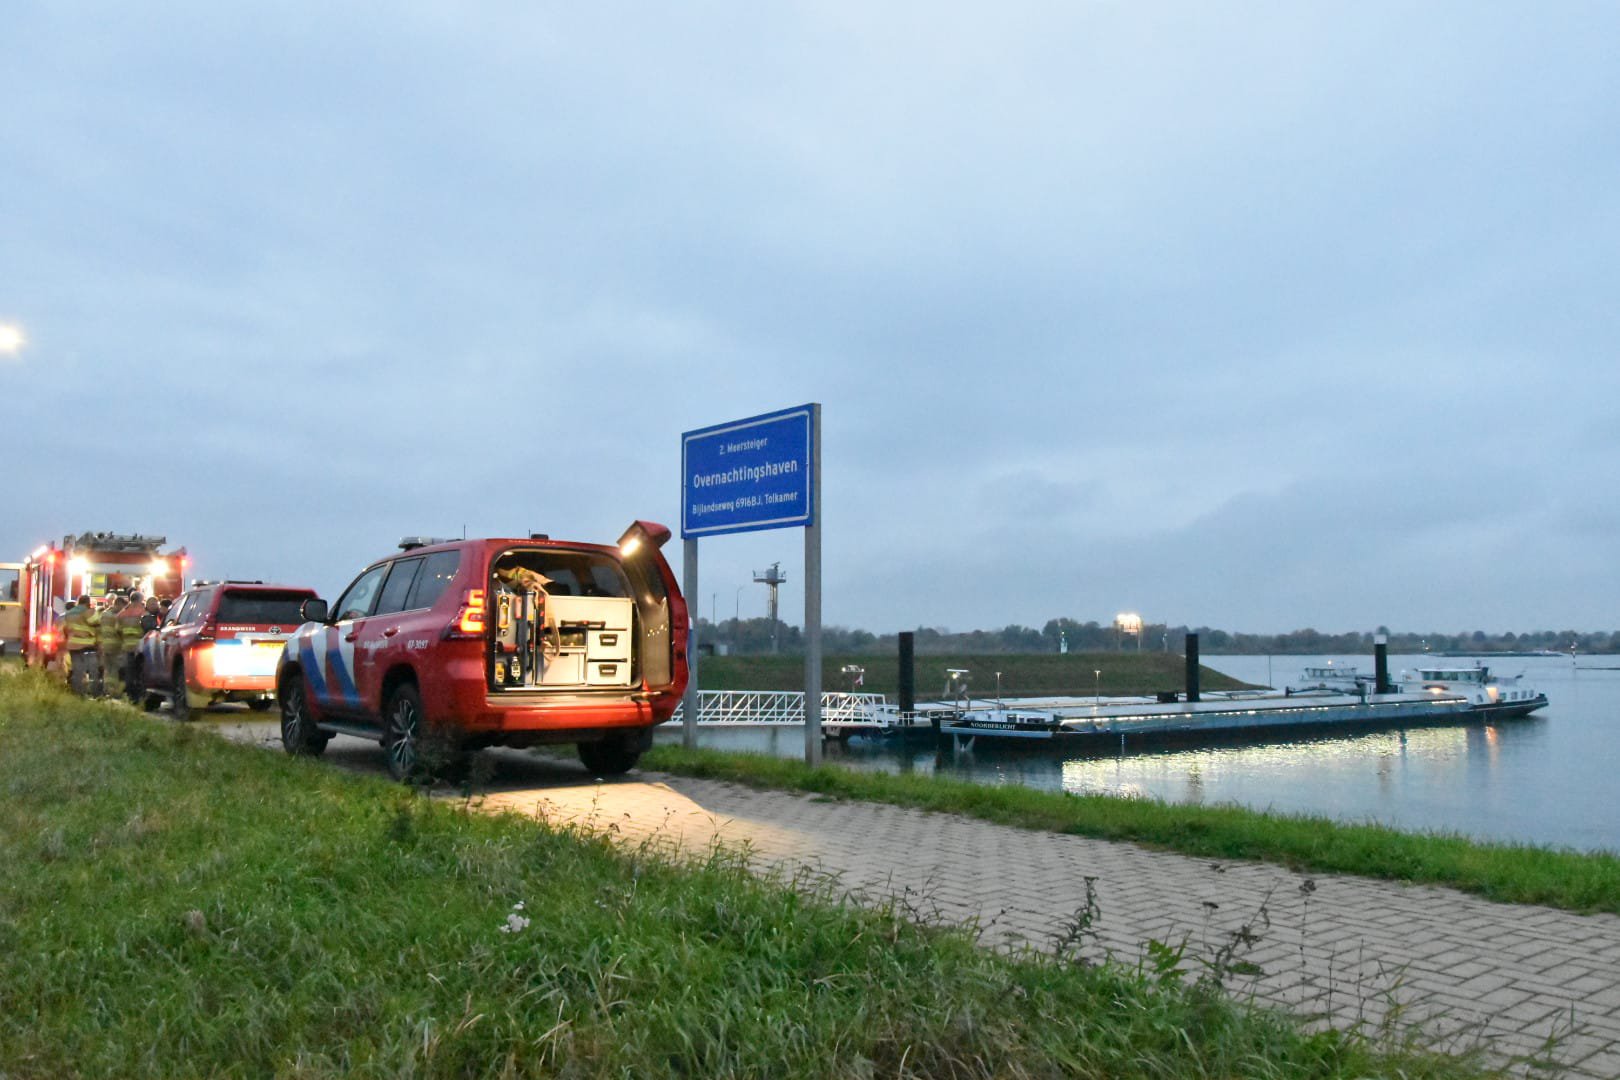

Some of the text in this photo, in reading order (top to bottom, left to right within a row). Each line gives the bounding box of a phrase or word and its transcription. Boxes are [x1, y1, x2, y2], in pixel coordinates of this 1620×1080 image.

[719, 437, 768, 455] 2. Meersteiger
[693, 459, 798, 488] Overnachtingshaven
[692, 501, 733, 516] Bijlandseweg
[764, 491, 798, 504] Tolkamer
